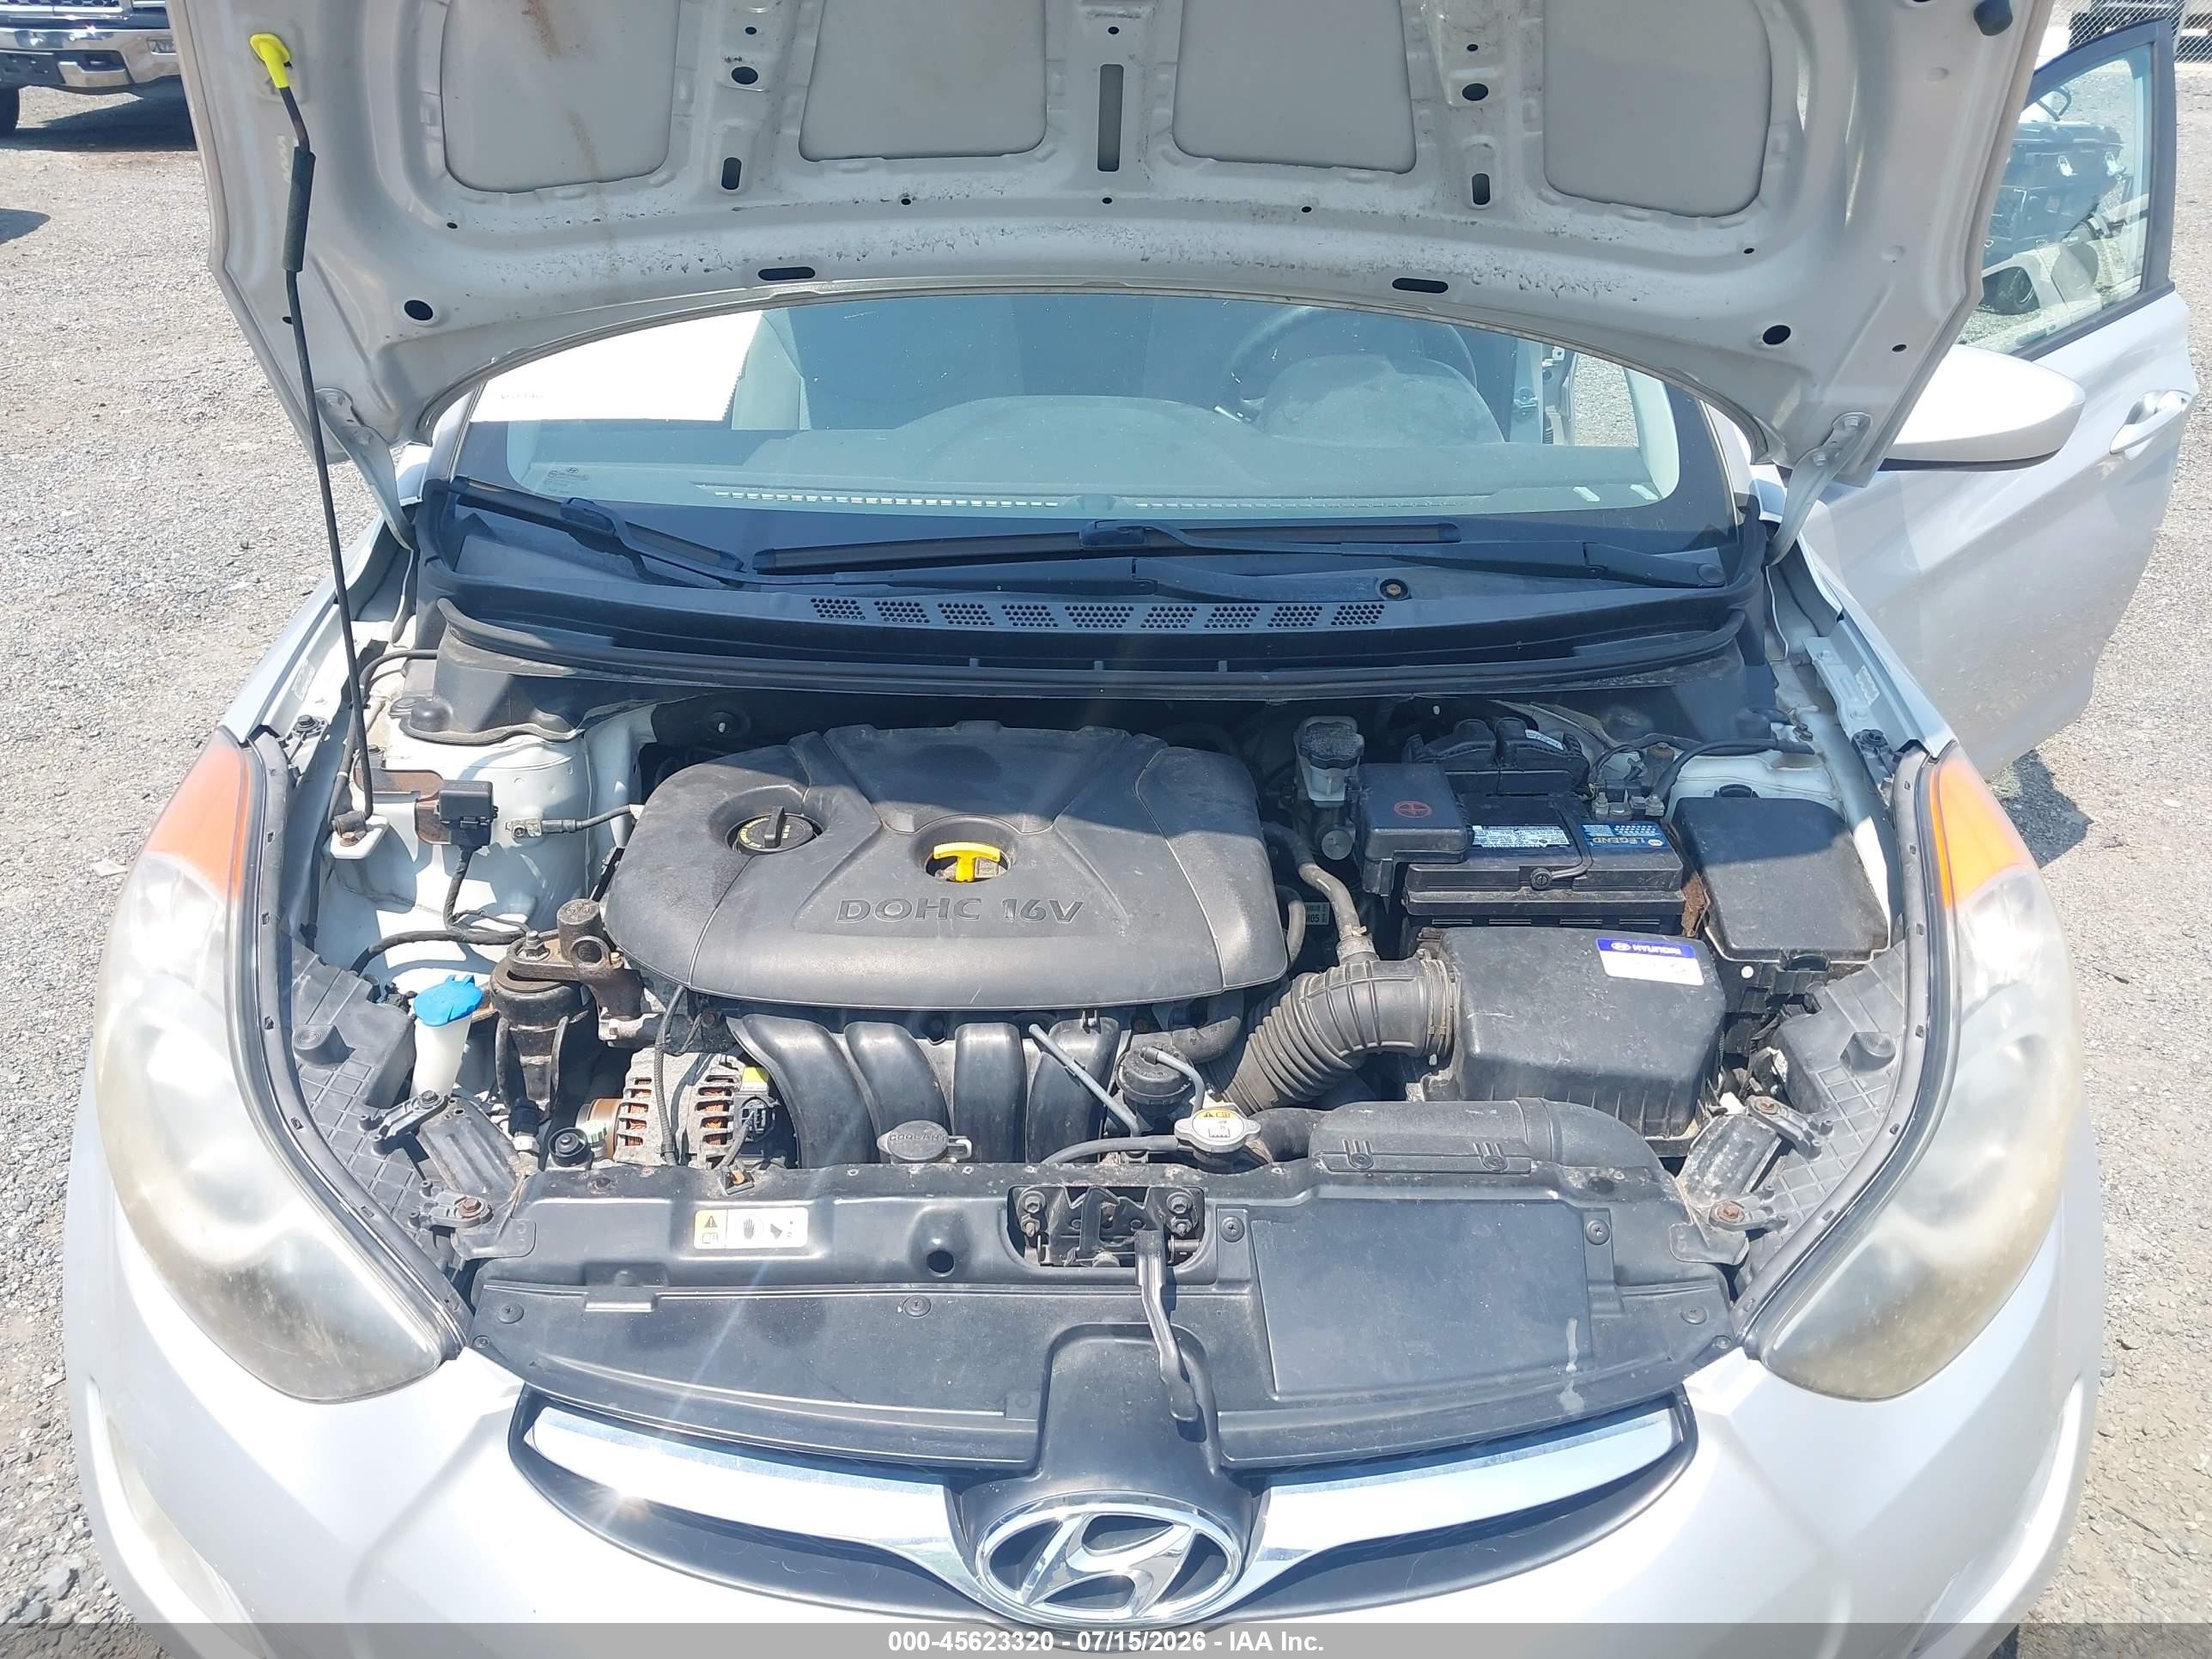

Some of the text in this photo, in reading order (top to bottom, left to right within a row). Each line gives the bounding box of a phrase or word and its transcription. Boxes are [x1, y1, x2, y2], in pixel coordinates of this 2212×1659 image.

[836, 897, 1084, 924] DOHC 16V
[1632, 945, 1682, 955] HYUNDAI
[889, 1133, 946, 1142] COOLANT
